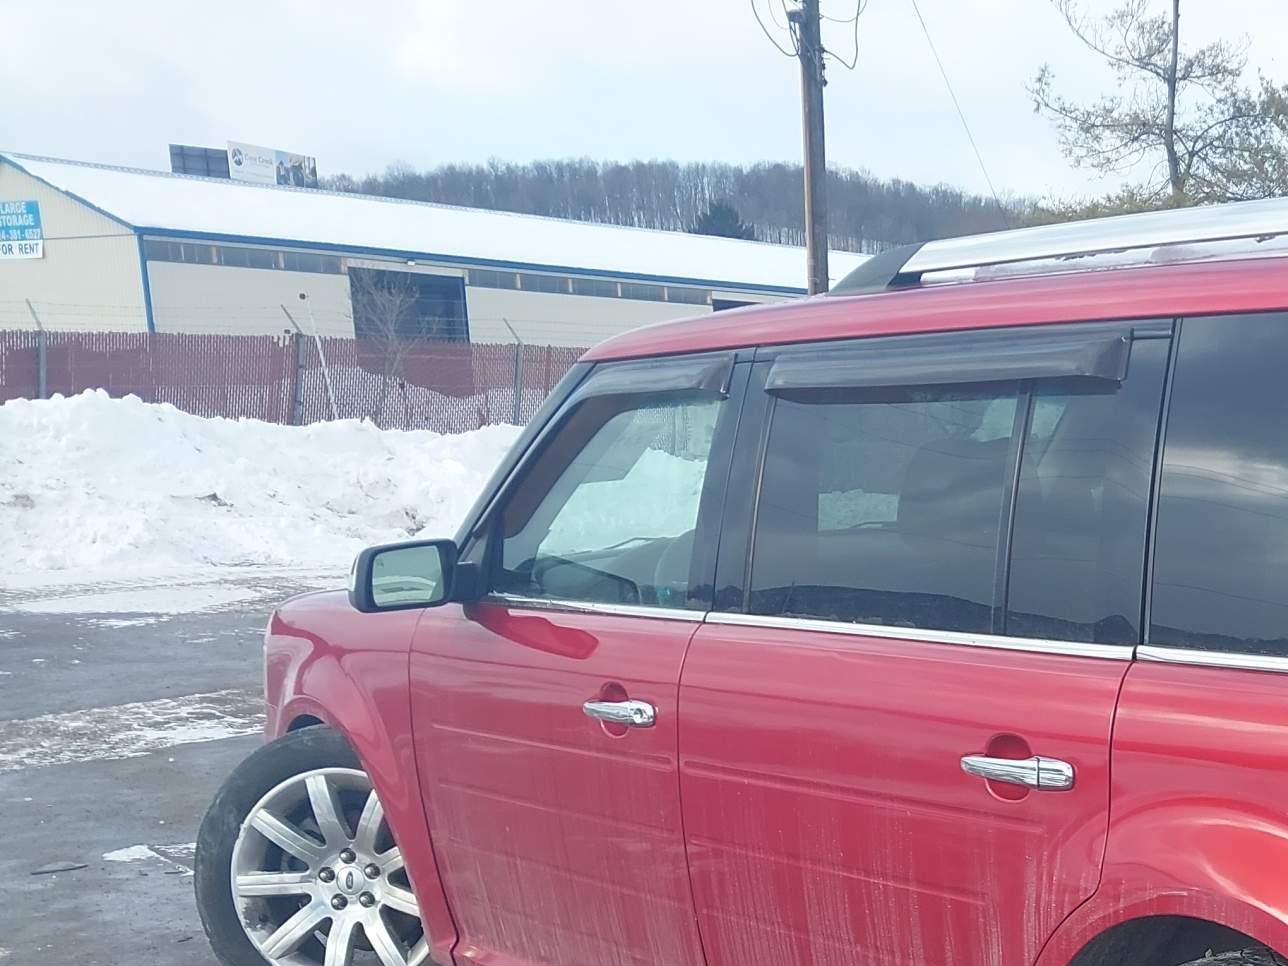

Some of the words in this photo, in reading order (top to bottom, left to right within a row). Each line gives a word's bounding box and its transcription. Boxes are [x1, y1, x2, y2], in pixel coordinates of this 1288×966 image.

[0, 201, 26, 214] LARGE
[0, 243, 14, 255] OR
[18, 243, 39, 255] RENT
